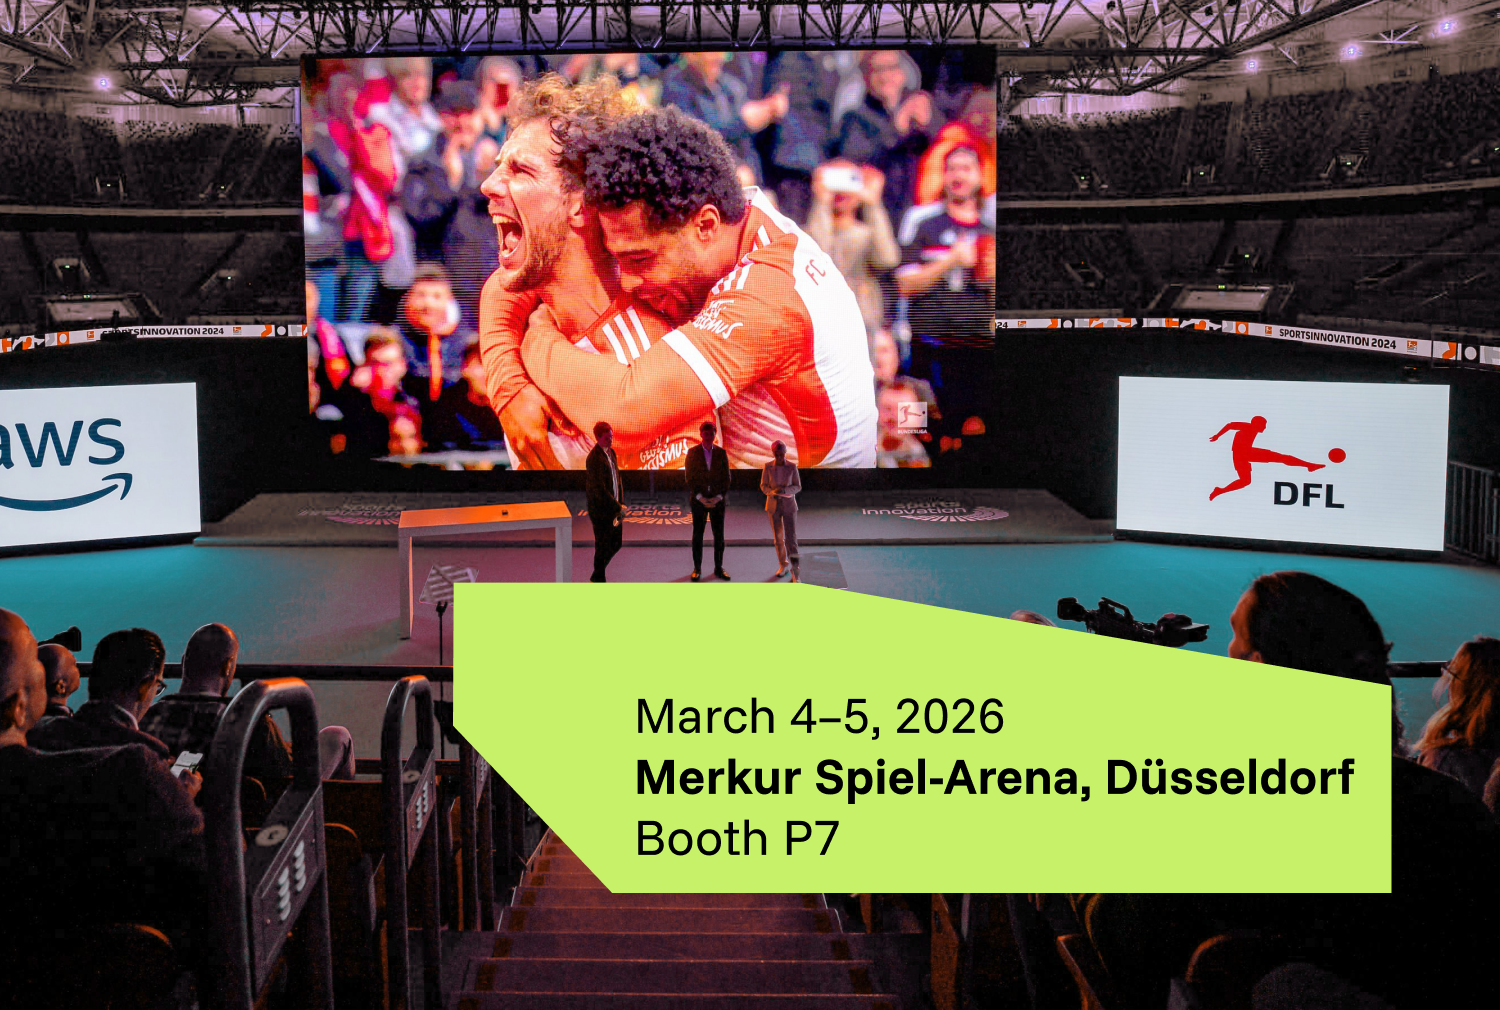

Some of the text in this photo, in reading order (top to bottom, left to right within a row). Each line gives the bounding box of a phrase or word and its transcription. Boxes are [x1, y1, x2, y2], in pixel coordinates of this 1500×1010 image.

[202, 327, 225, 335] 2024
[1280, 328, 1397, 350] SPORTSINNOVATION 2024
[1273, 481, 1345, 509] DFL
